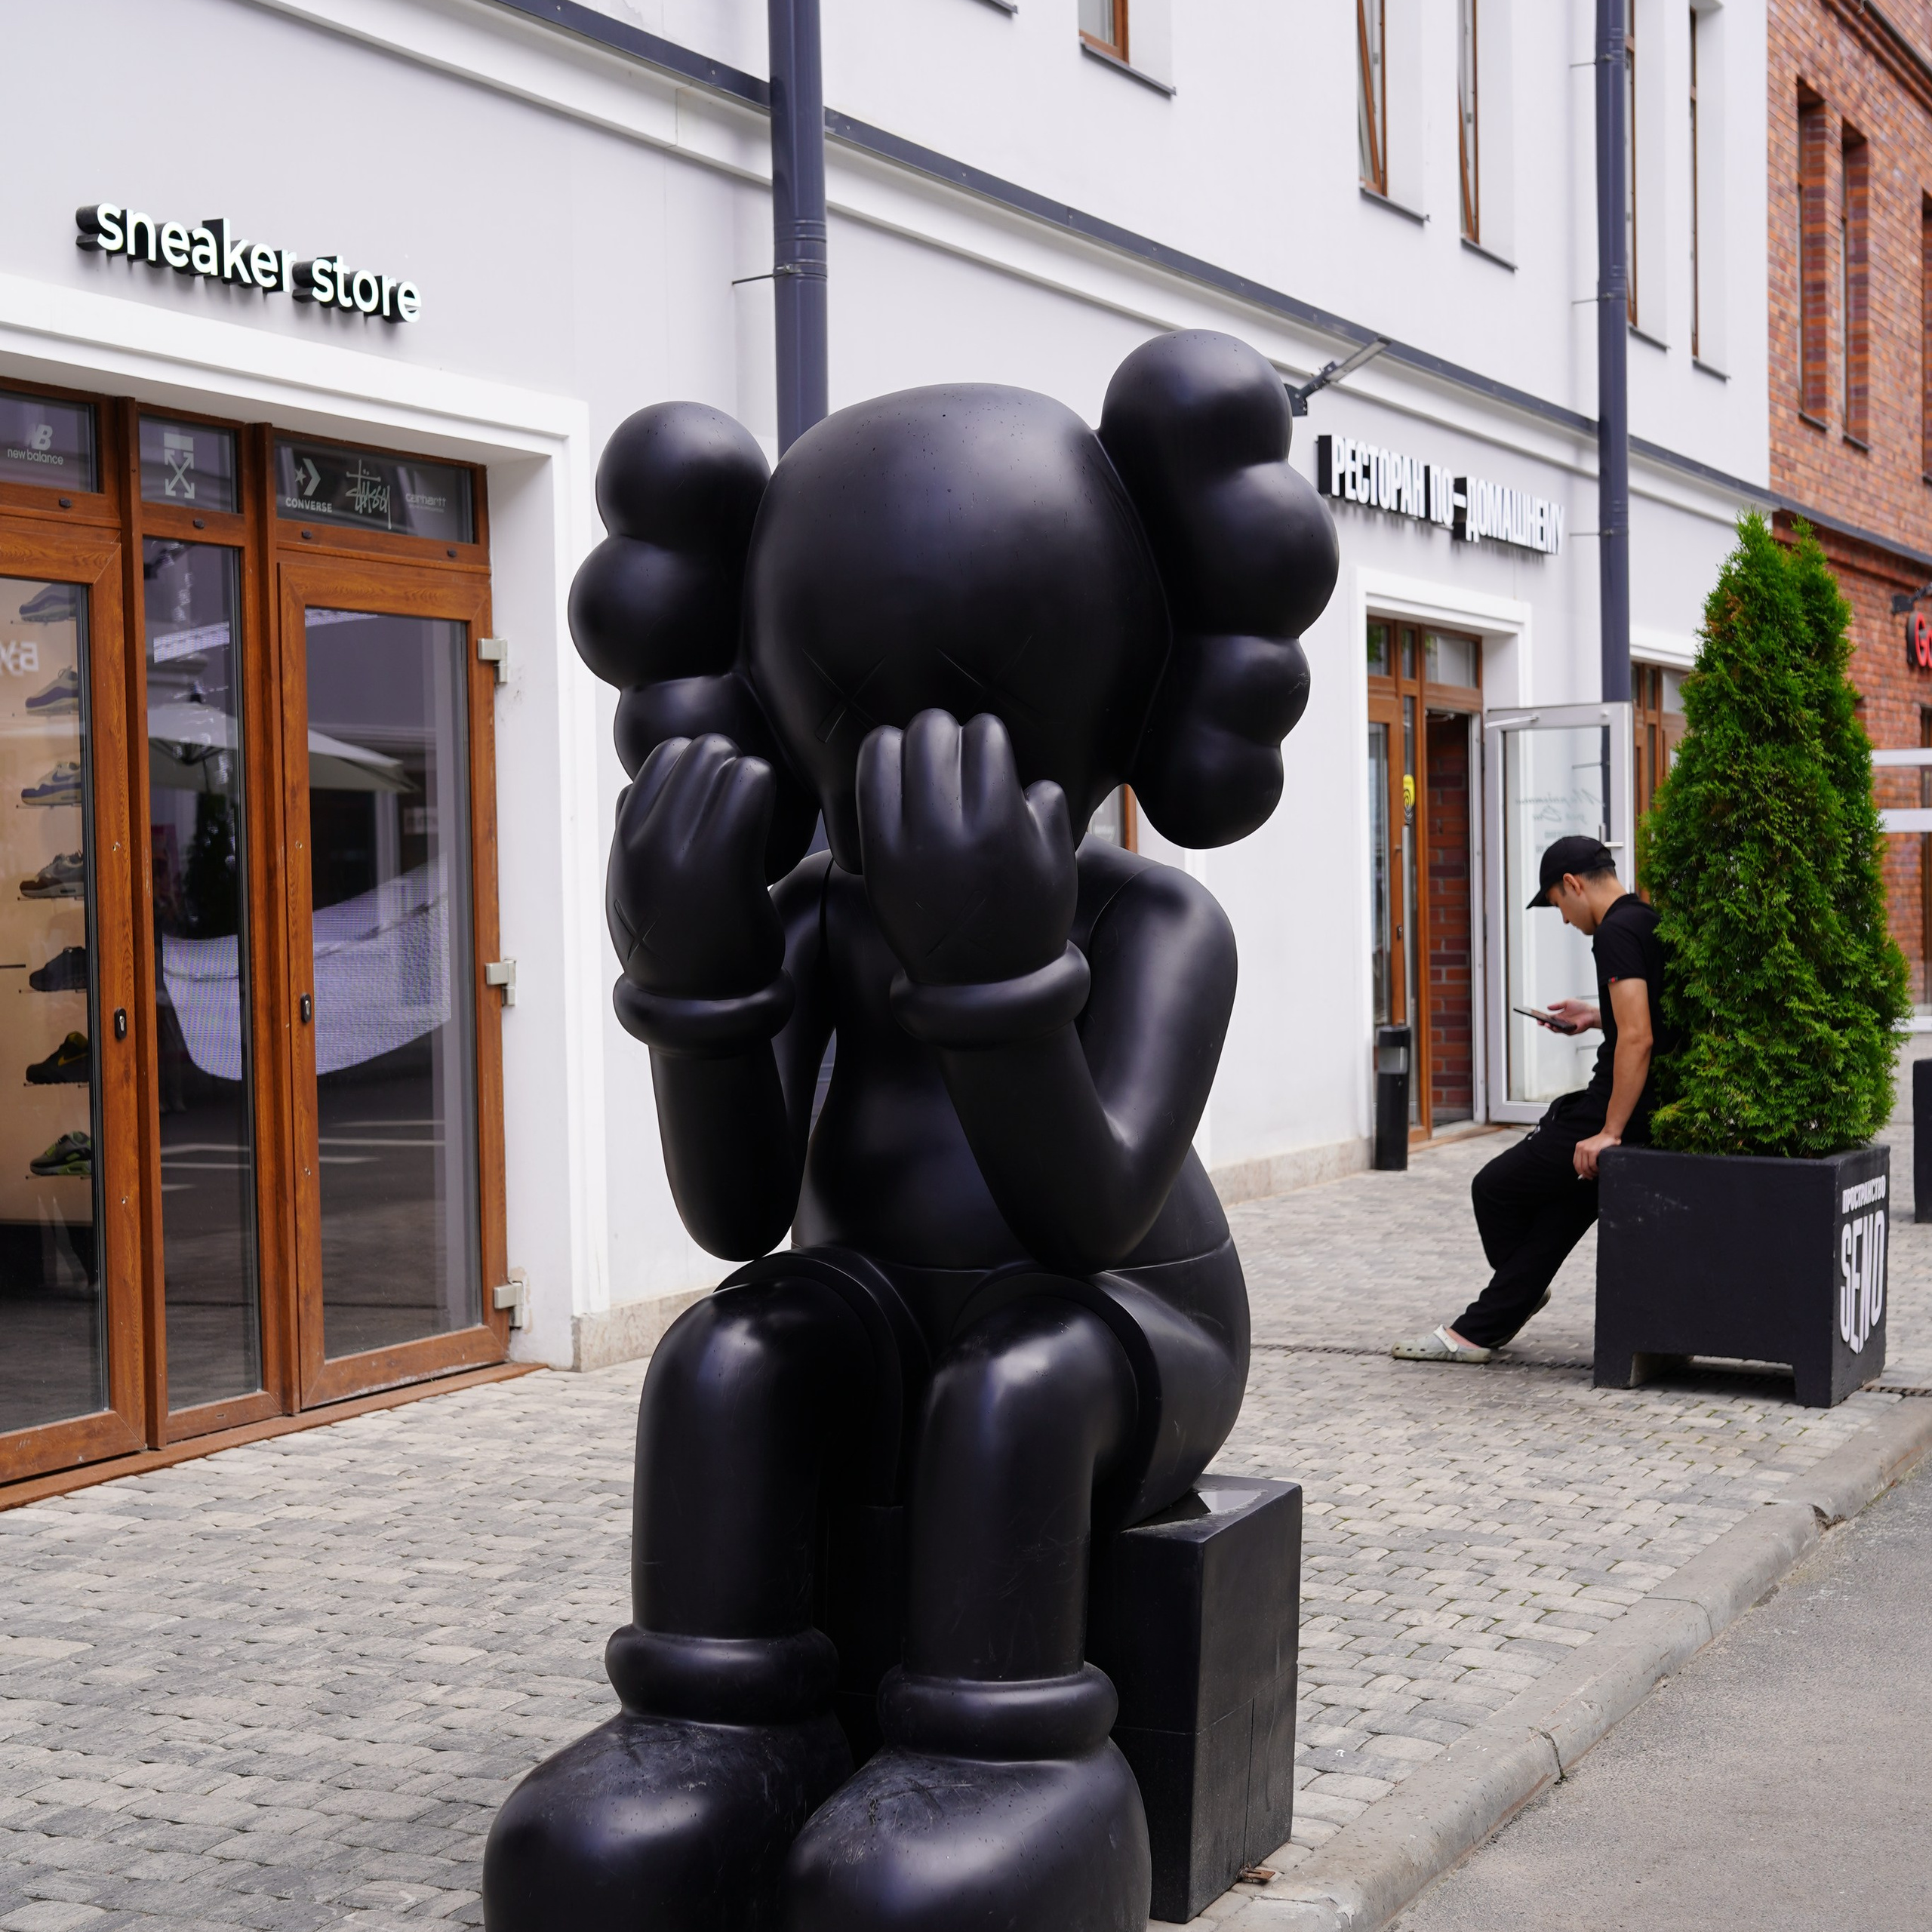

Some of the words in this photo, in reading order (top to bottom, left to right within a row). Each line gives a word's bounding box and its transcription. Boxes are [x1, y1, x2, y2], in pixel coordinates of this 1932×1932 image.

[97, 202, 297, 293] sneaker
[311, 254, 422, 323] store
[7, 448, 26, 460] new
[26, 449, 63, 465] balance
[1331, 435, 1426, 518] РЕСТОРАН
[285, 497, 333, 513] CONVERSE
[1842, 1174, 1886, 1214] ПРОСТРАНСТВО
[1840, 1209, 1885, 1355] SENO
